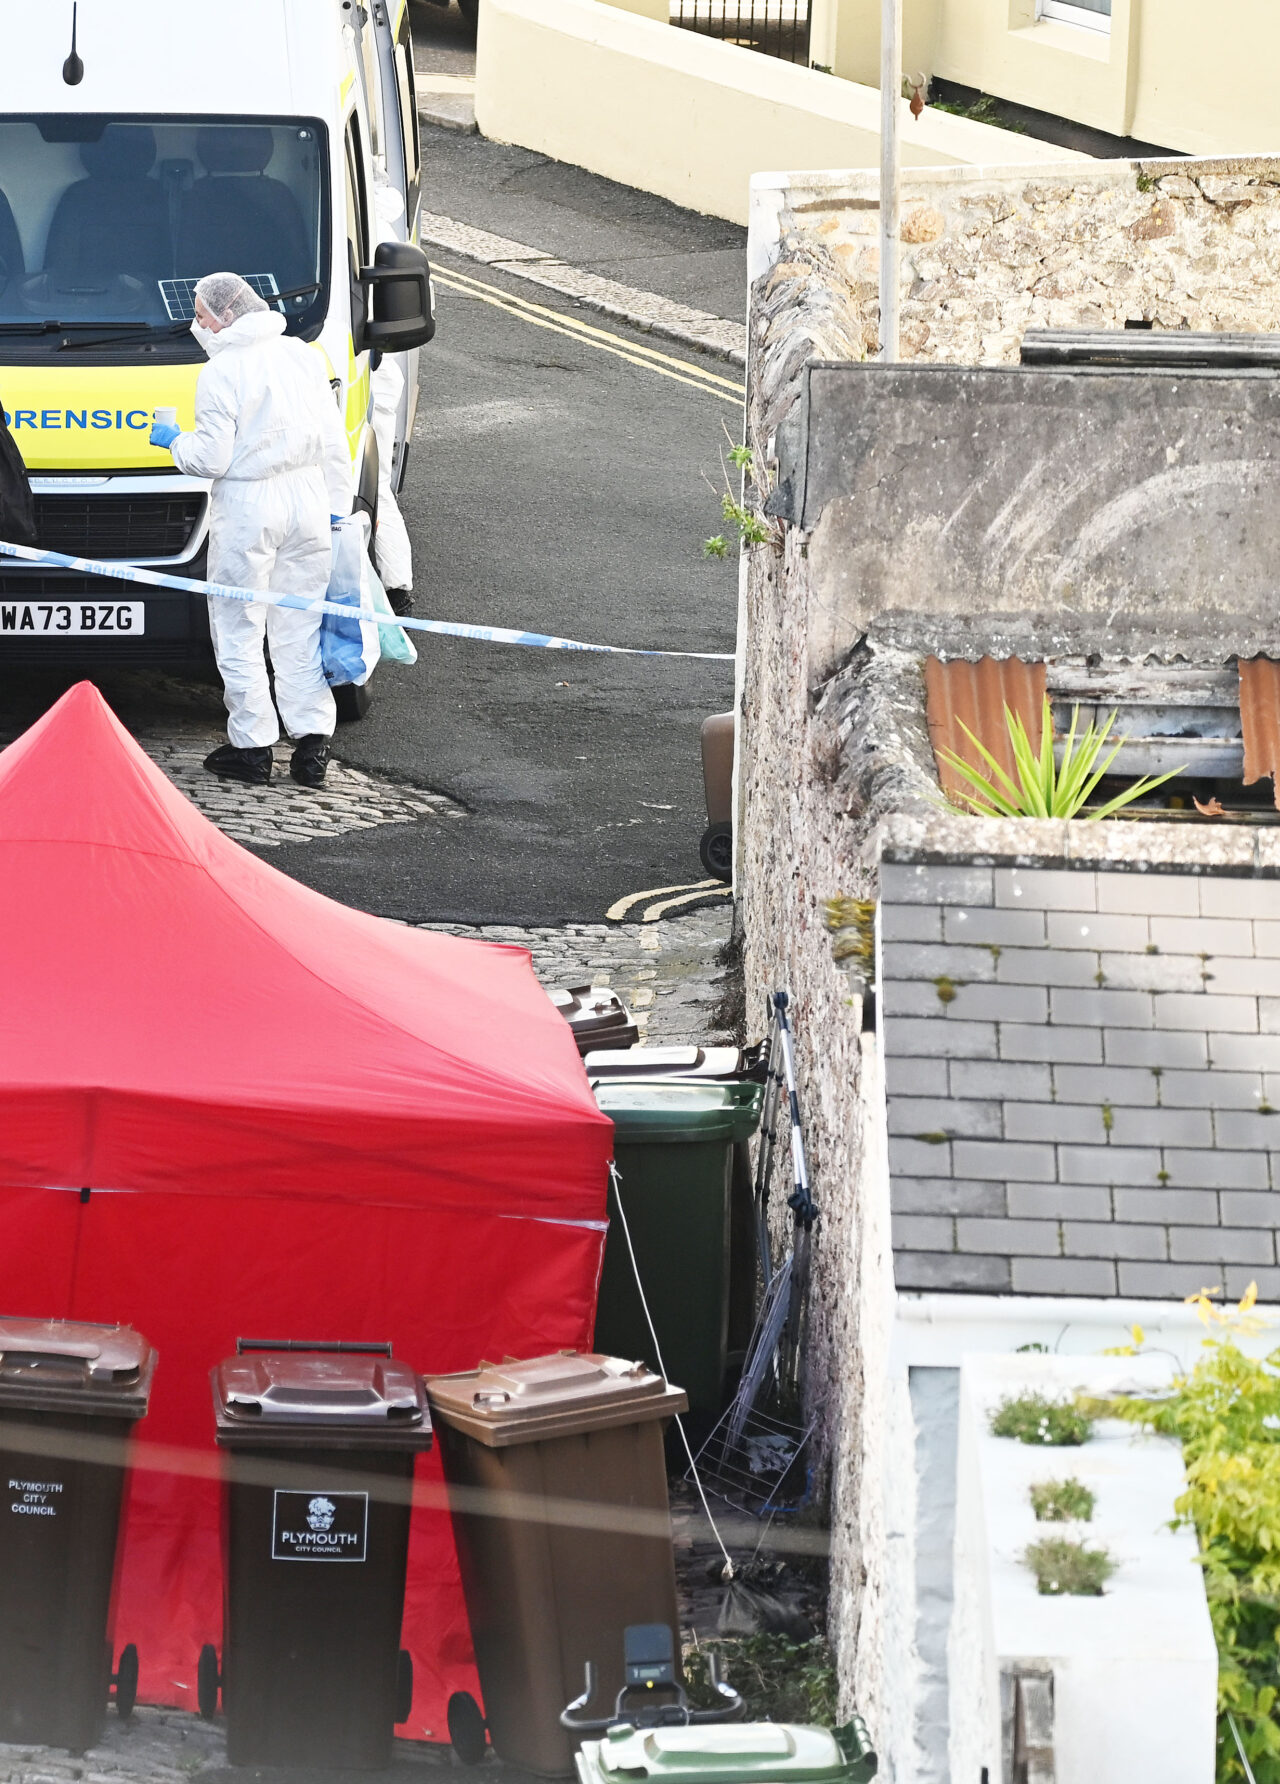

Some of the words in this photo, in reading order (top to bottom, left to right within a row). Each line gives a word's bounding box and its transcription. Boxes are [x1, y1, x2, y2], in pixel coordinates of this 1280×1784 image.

[3, 409, 157, 430] RENSIC
[1, 605, 71, 630] WA73
[80, 605, 132, 630] BZG
[8, 1480, 63, 1492] PLYMOUTH
[23, 1494, 47, 1504] CITY
[11, 1504, 56, 1516] COUNCIL
[282, 1531, 358, 1545] PLYMOUTH
